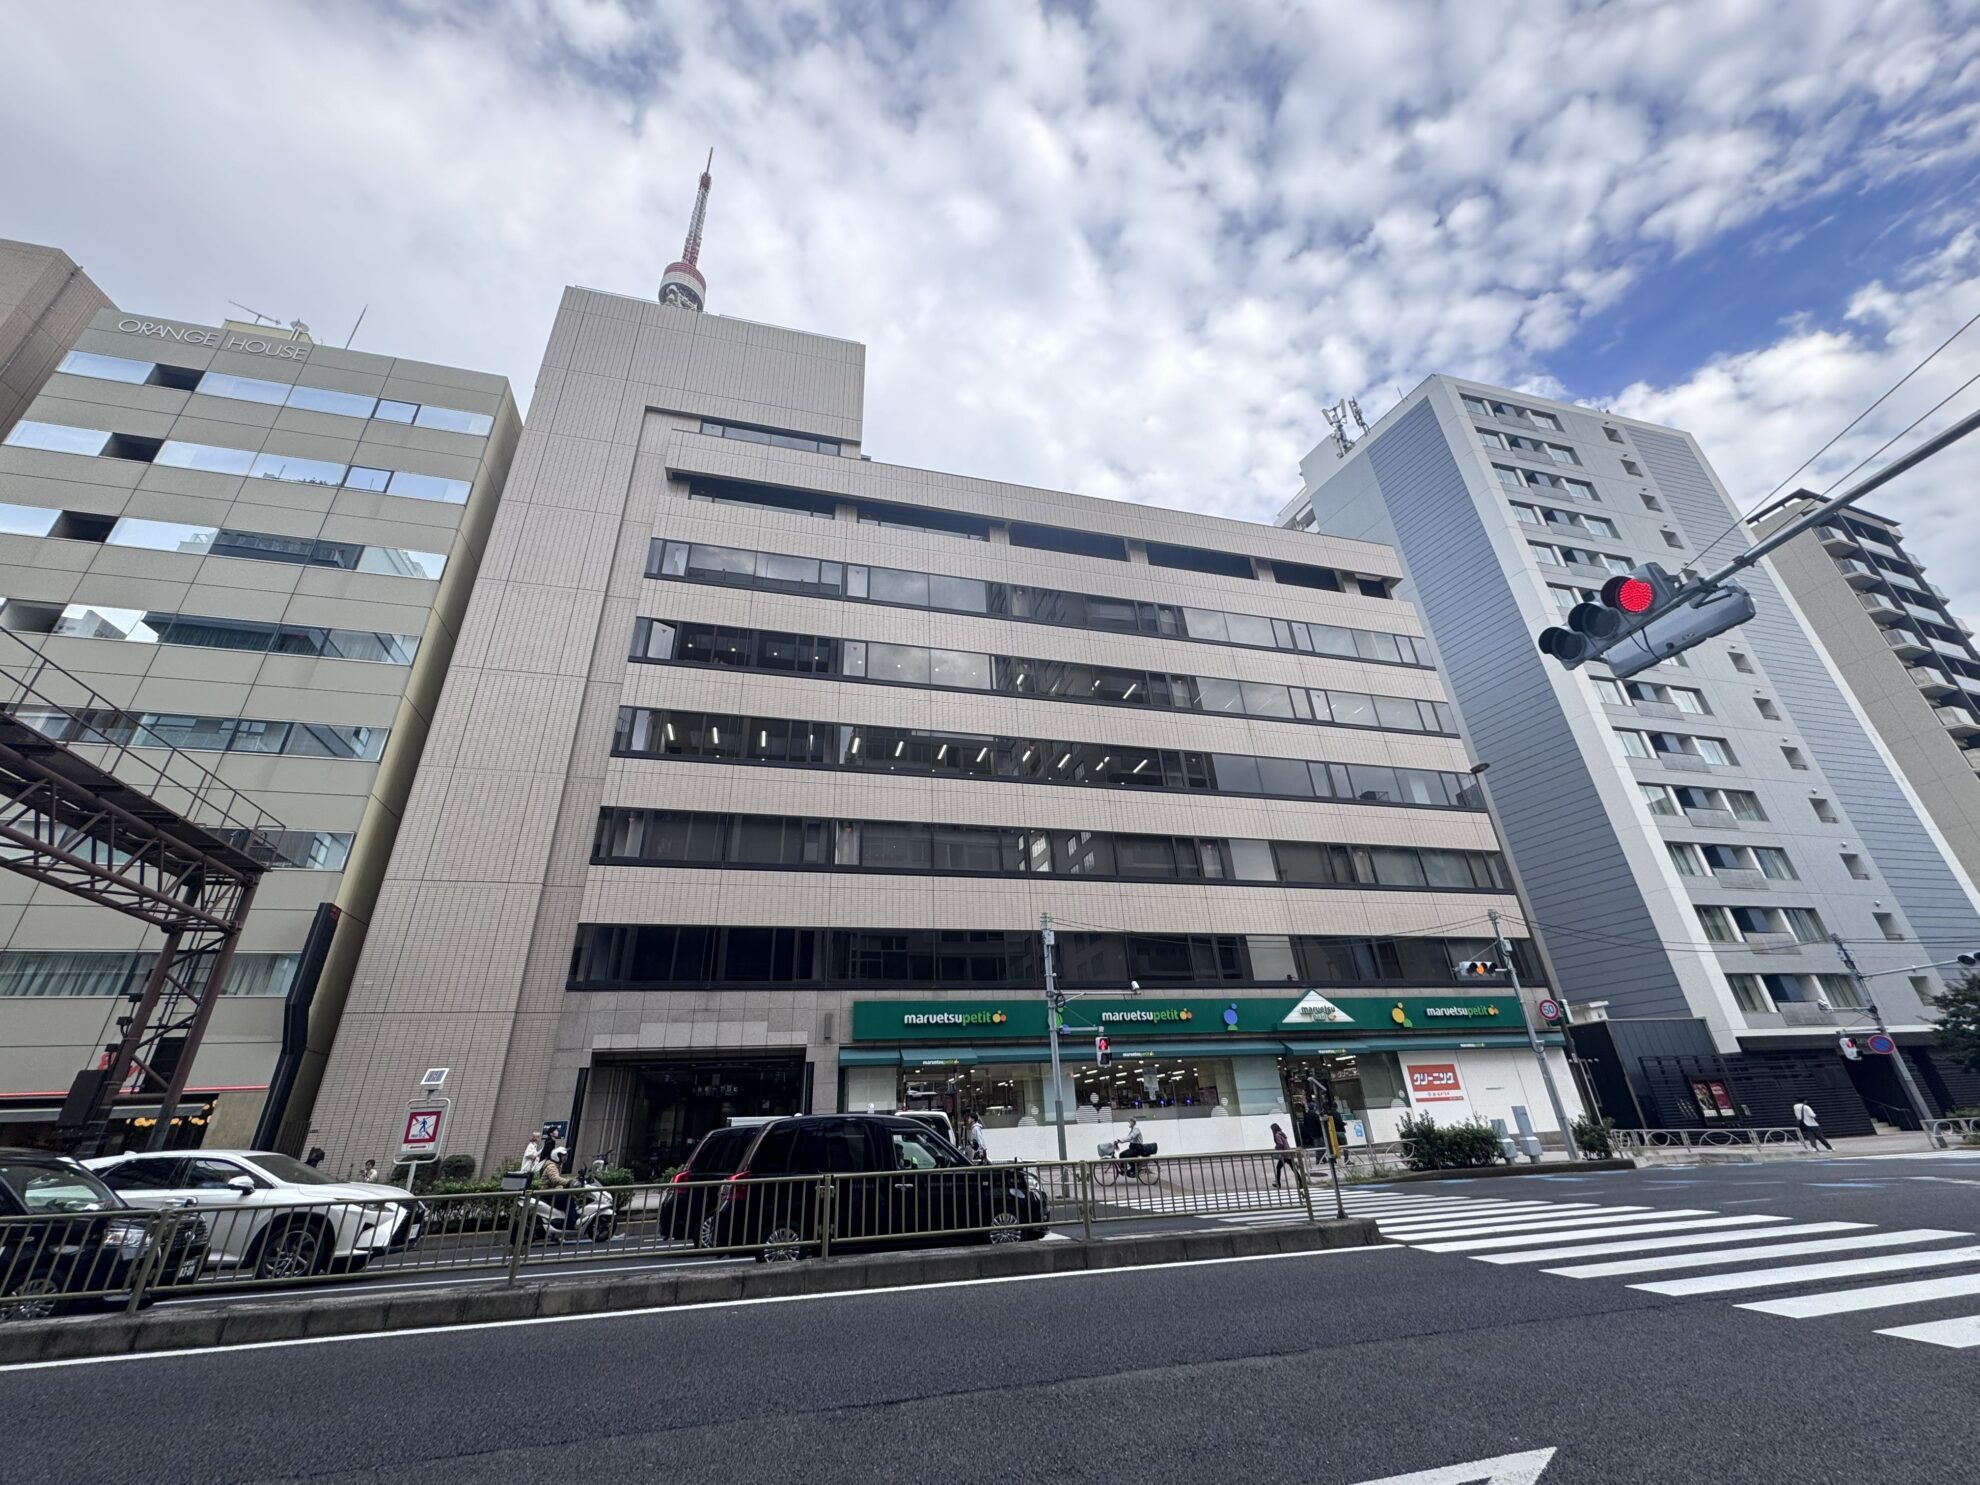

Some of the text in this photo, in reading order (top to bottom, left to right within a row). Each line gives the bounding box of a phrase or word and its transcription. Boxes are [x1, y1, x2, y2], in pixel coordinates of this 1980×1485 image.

[118, 319, 308, 362] ORANGE HOUSE
[1102, 1009, 1179, 1023] maruetsupetit
[1427, 1006, 1488, 1018] maruetsupetit
[1542, 1004, 1555, 1015] 50
[904, 1010, 991, 1026] maruetsupetit
